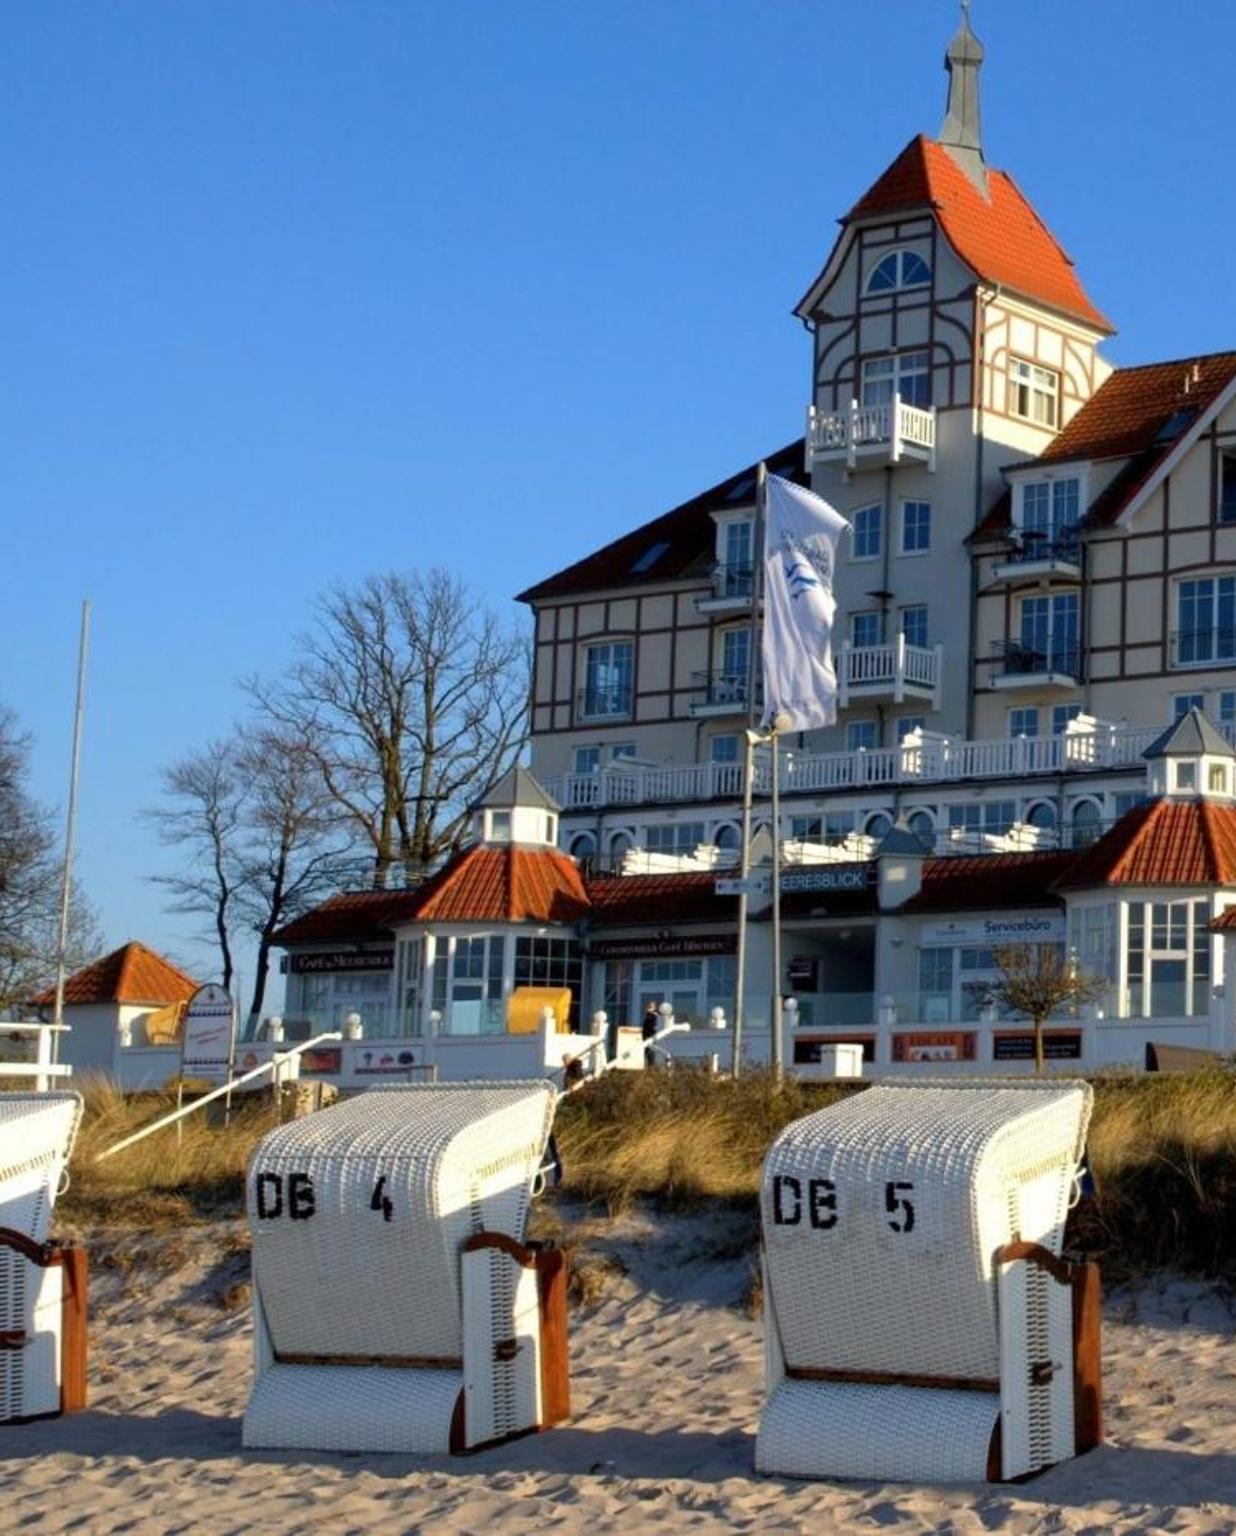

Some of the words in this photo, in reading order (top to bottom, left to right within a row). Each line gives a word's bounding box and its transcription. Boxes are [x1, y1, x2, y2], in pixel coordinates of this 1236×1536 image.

[776, 873, 863, 890] EERESBLICK
[984, 918, 1052, 933] Servicebüro
[257, 1173, 316, 1220] DB
[370, 1176, 393, 1222] 4
[773, 1176, 837, 1230] DB
[886, 1182, 915, 1232] 5
